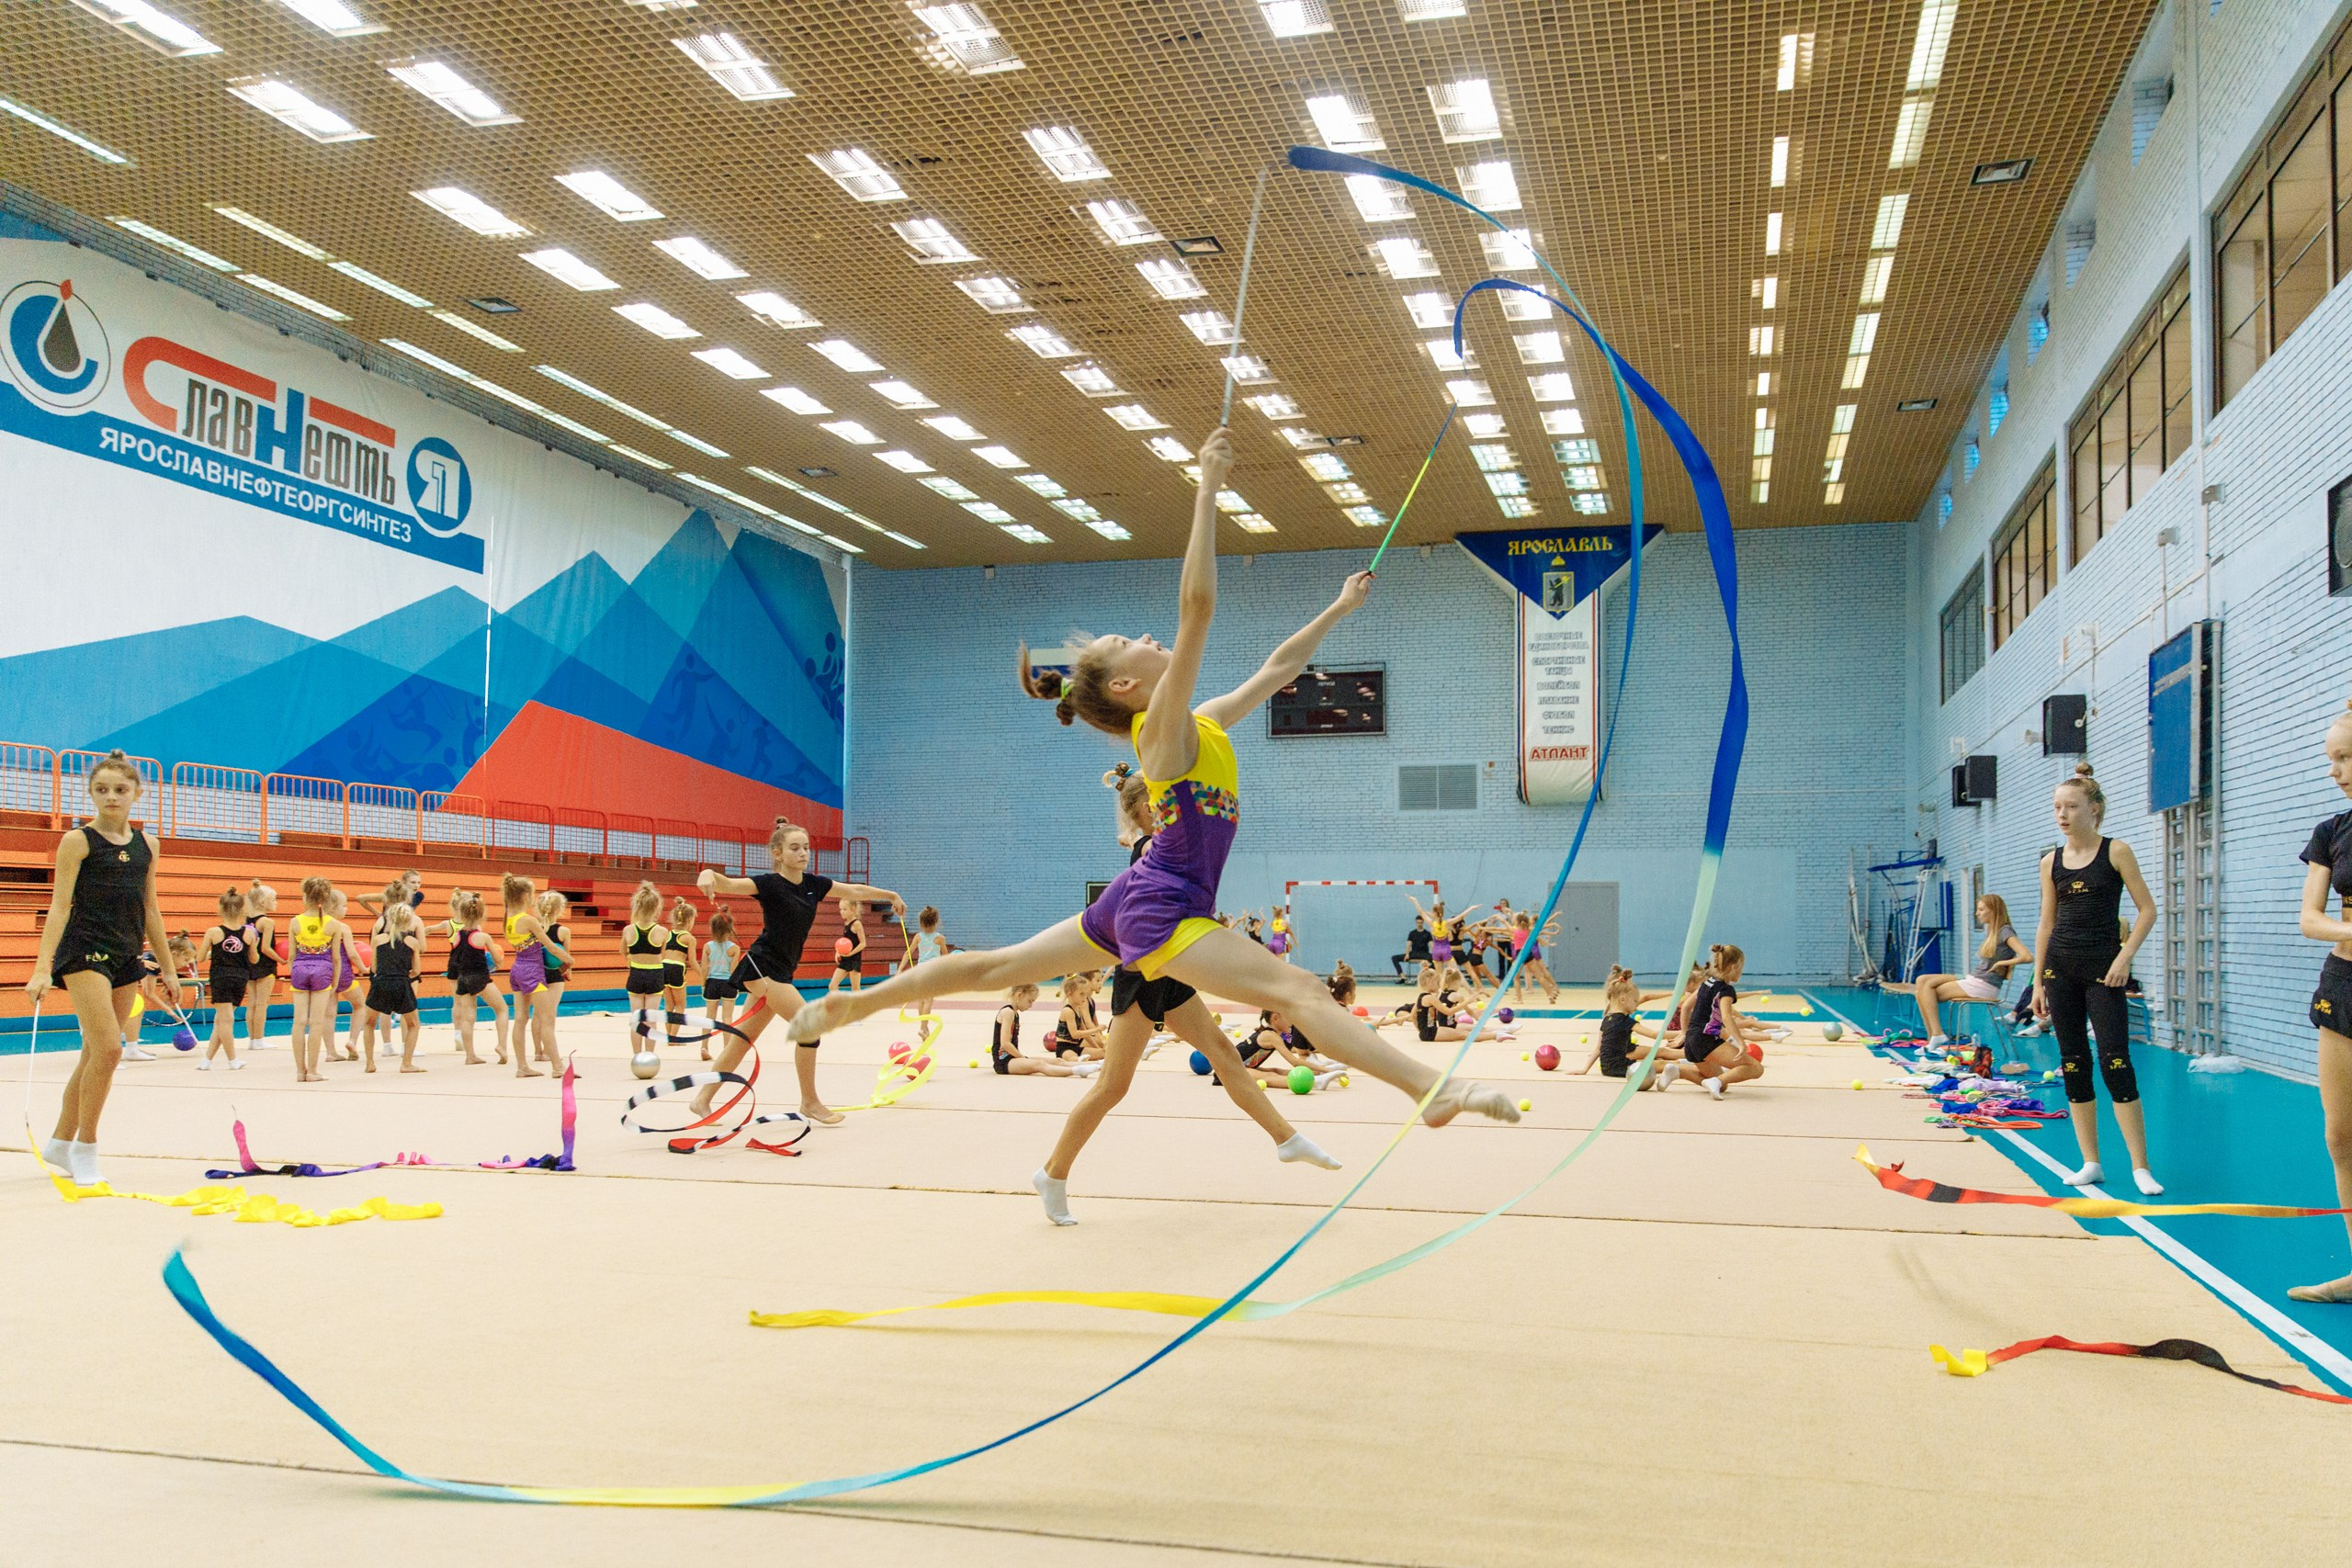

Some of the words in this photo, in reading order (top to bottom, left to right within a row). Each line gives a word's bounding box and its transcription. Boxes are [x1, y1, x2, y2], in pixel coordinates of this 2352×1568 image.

[98, 425, 412, 544] ЯРОСЛАВНЕФТЕОРГСИНТЕЗ
[1508, 536, 1613, 556] ЯРОСЛАВЛЬ
[1537, 680, 1580, 690] ВОЛЕЙБОЛ
[1537, 696, 1579, 705] ПЛАВАНИЕ
[1542, 711, 1575, 719] ФУТБОЛ
[1542, 726, 1574, 734] ТЕННИС
[1530, 746, 1589, 761] АТЛАНТ
